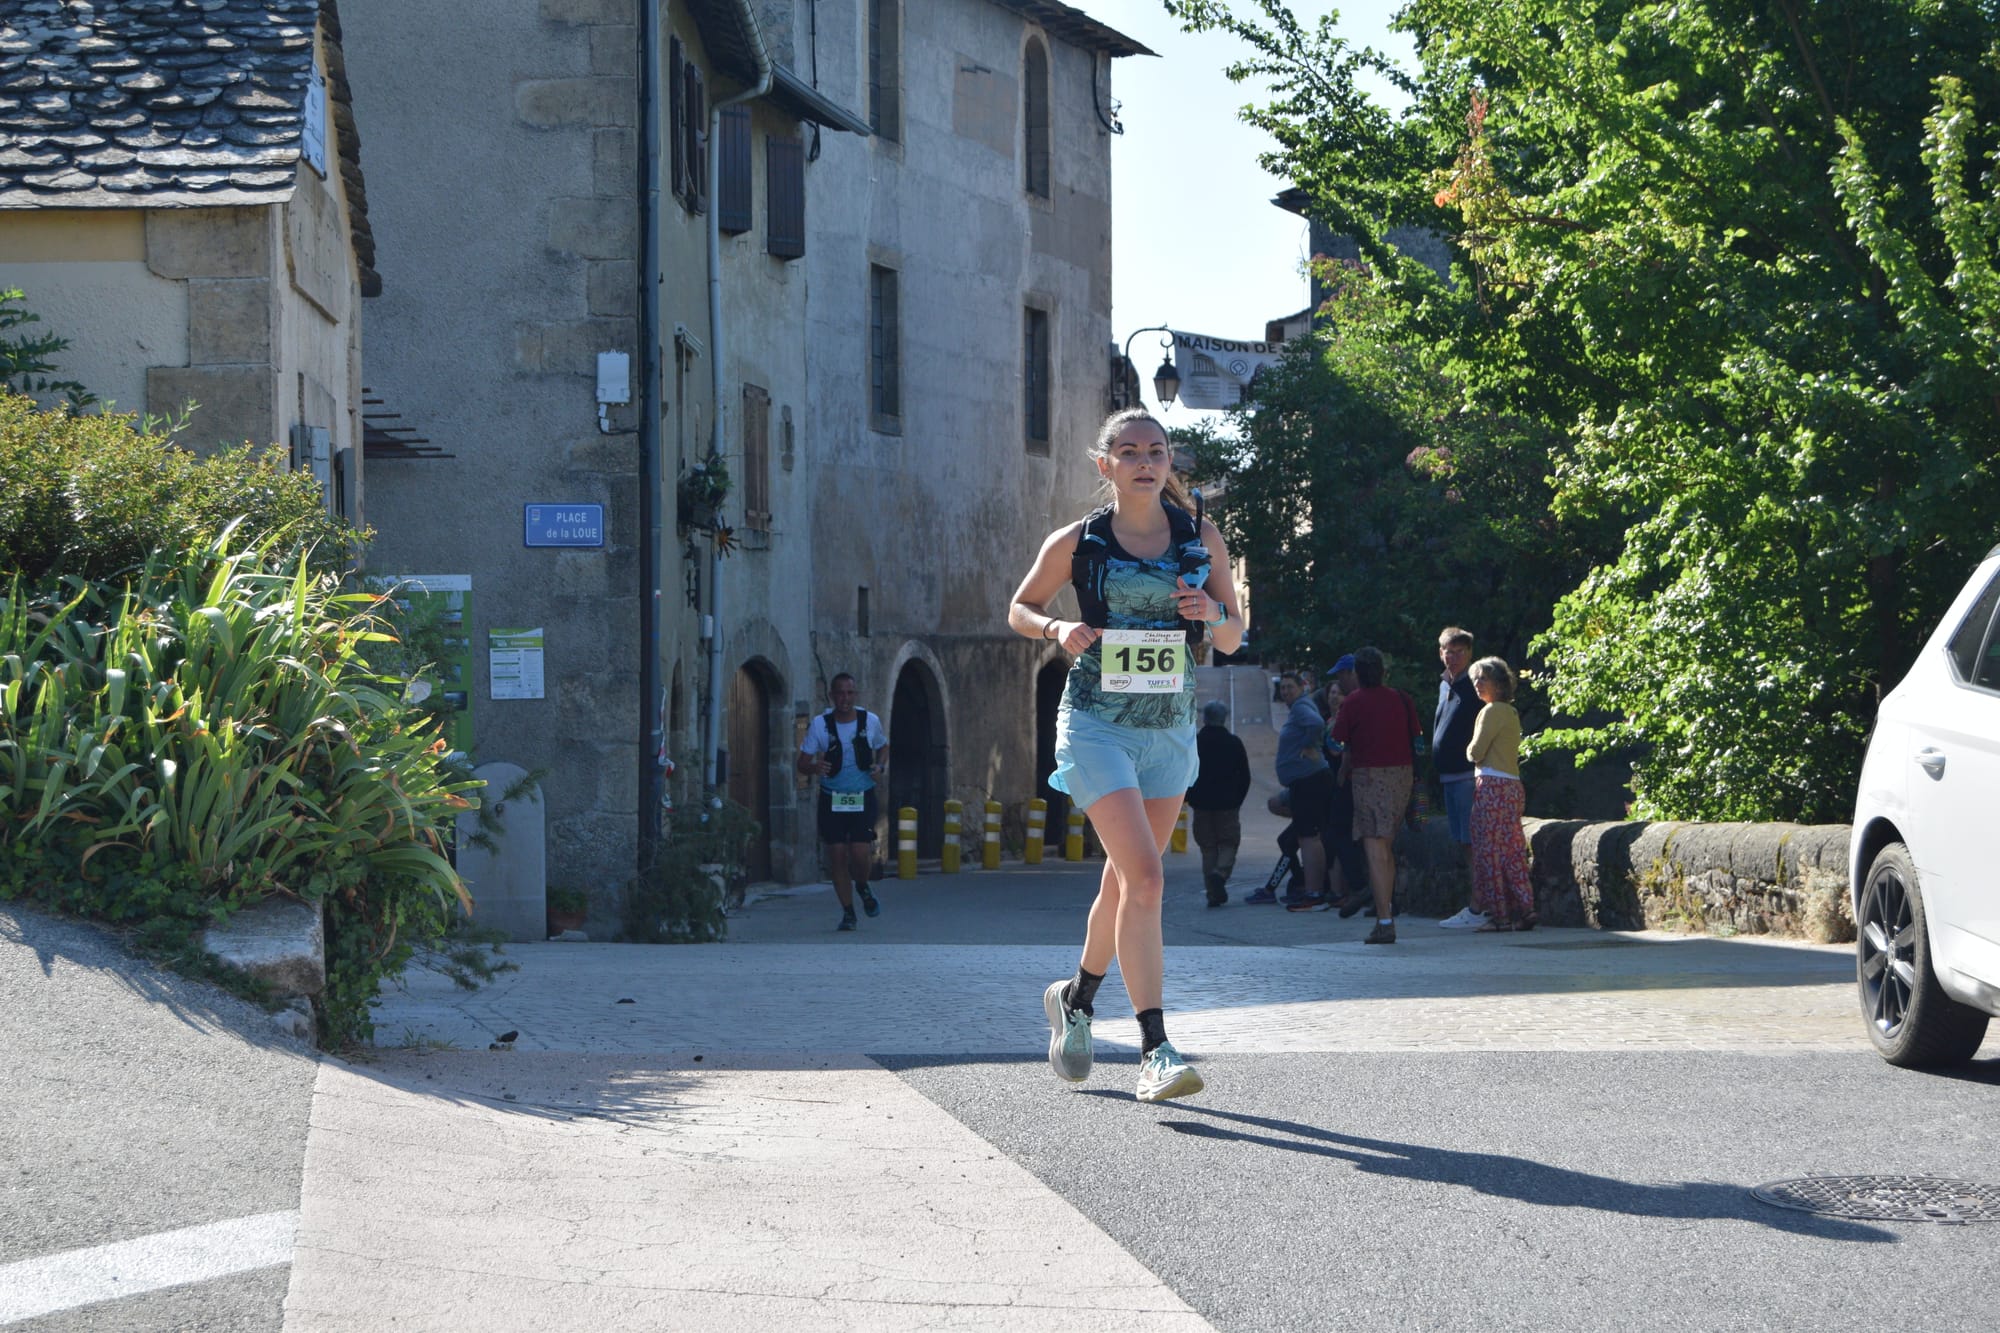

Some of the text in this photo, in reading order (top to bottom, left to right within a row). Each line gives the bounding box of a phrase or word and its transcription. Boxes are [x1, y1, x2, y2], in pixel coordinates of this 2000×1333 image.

[1179, 335, 1278, 354] MAISON DE
[556, 512, 587, 523] PLACE
[546, 528, 598, 538] de la LOUE
[1115, 647, 1175, 673] 156
[840, 796, 856, 806] 55
